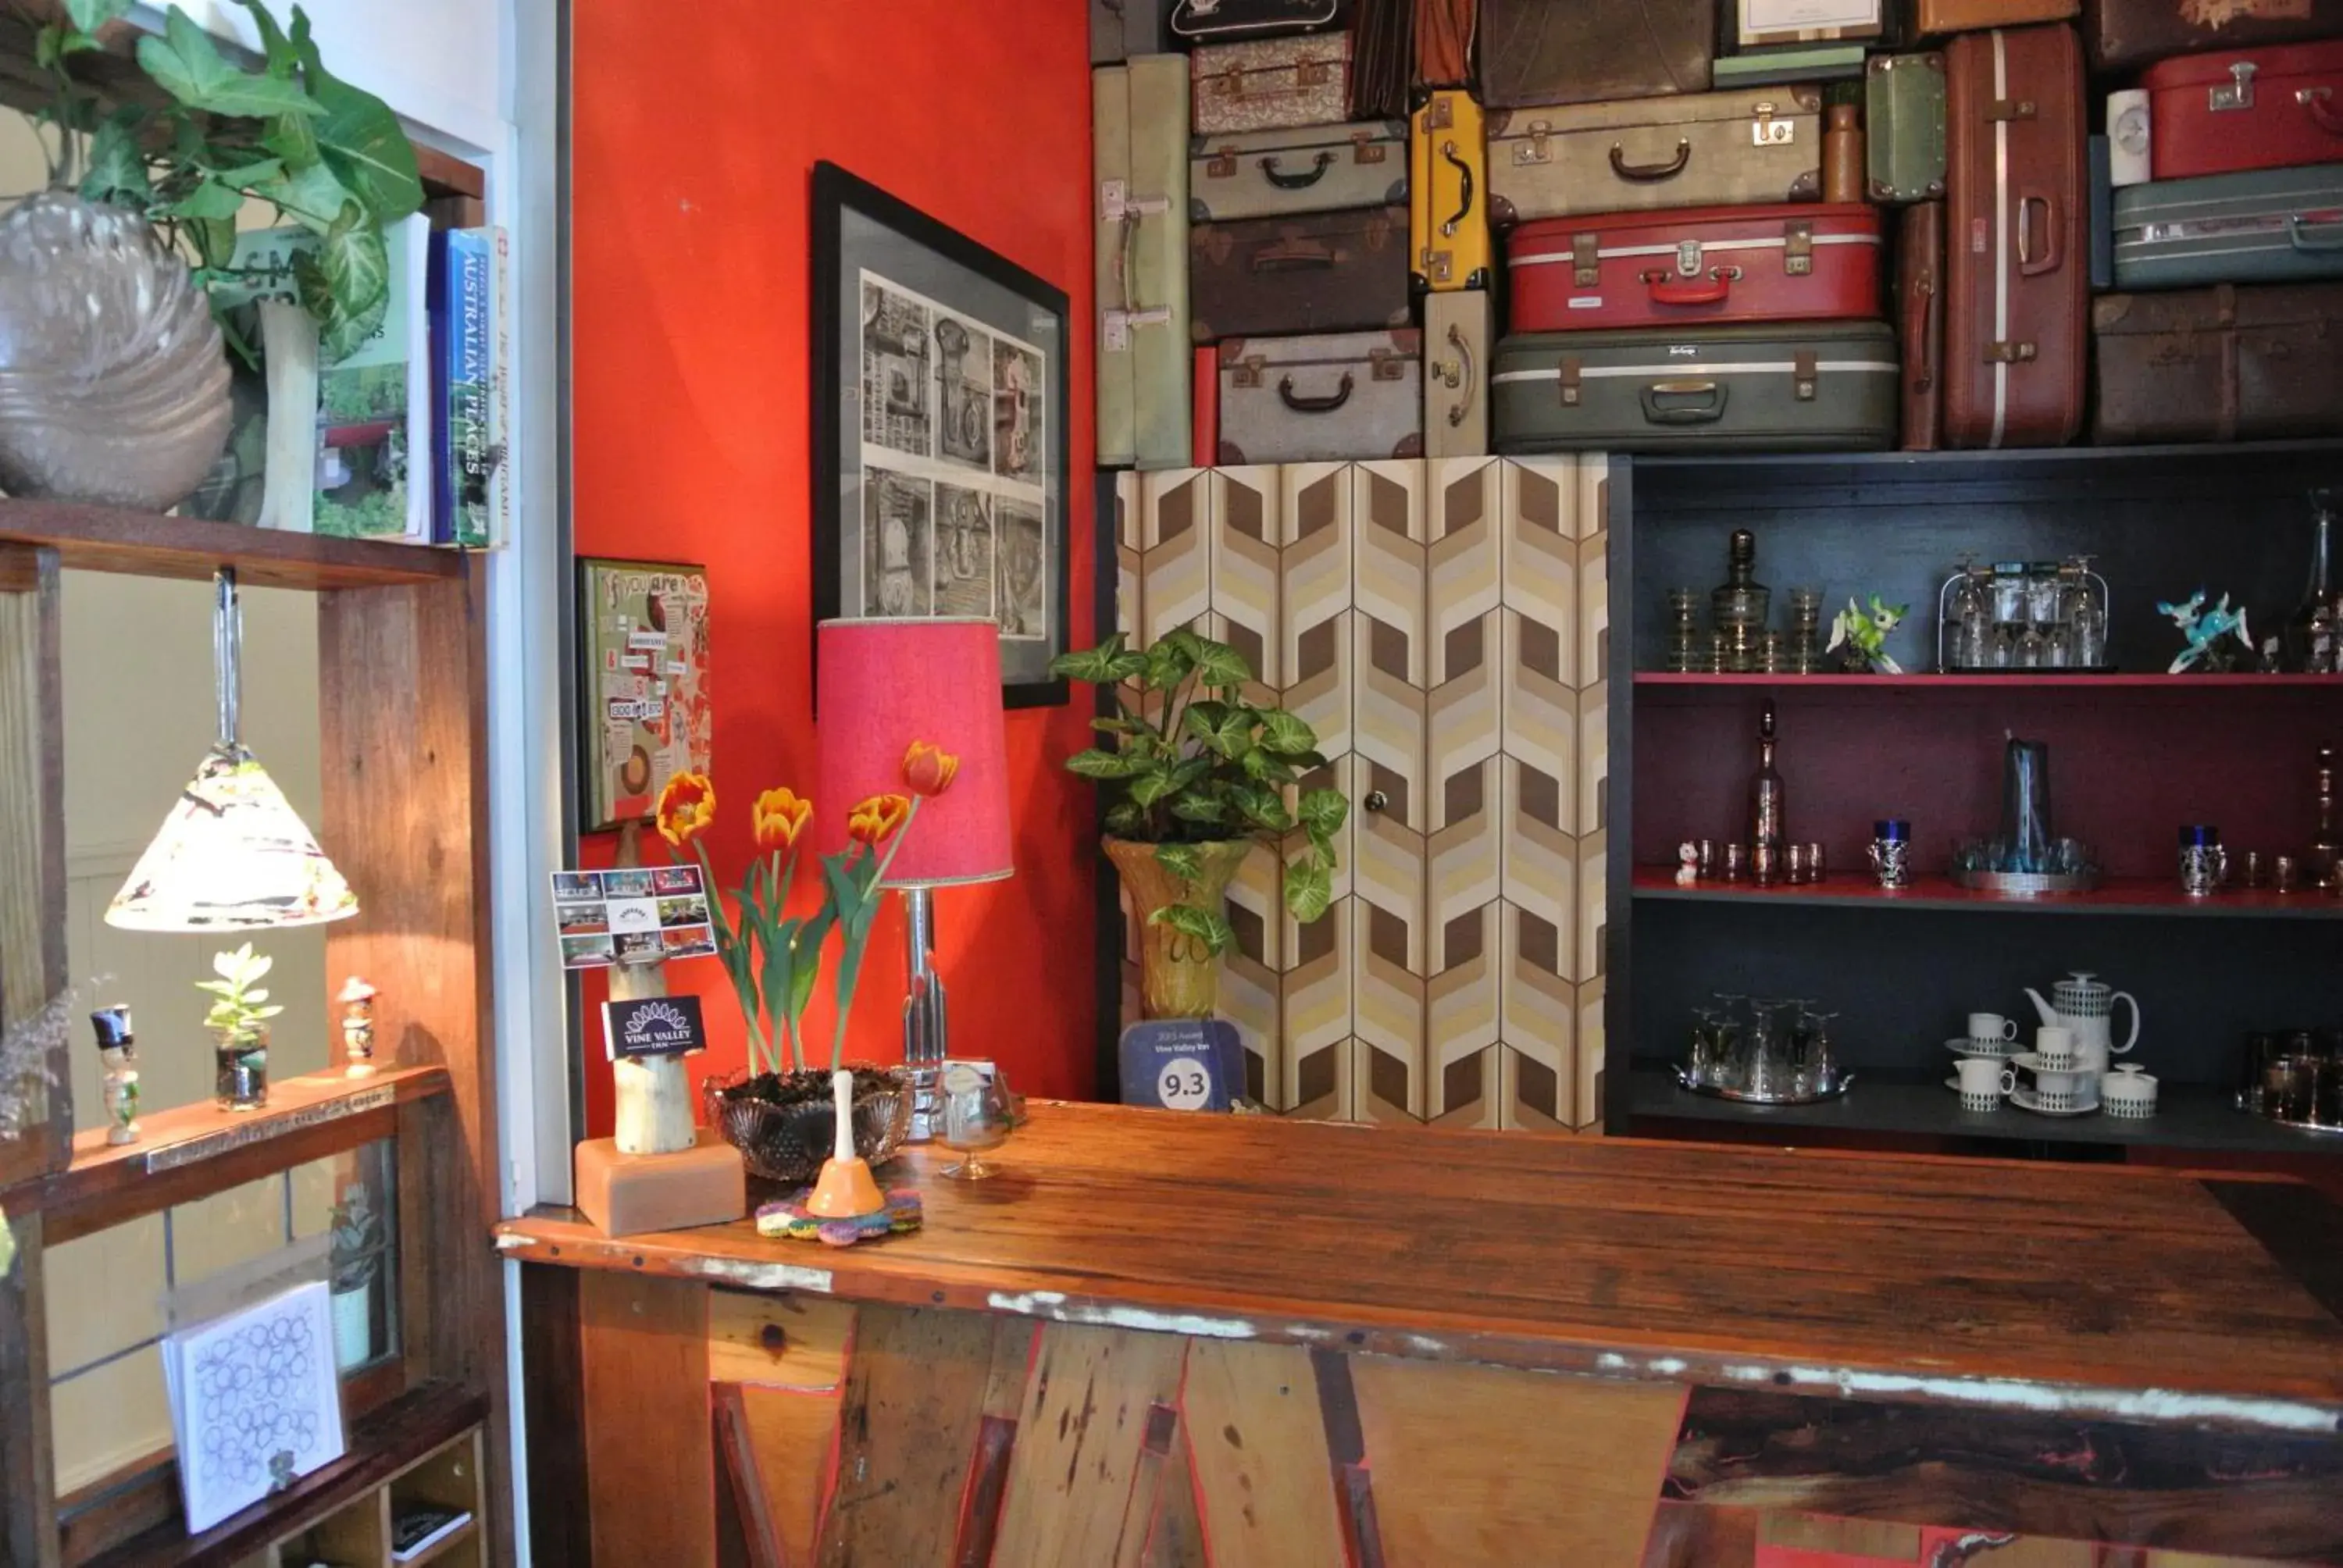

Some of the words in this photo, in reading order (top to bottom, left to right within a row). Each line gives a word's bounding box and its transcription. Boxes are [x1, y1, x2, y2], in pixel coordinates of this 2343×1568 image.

[465, 253, 478, 387] AUSTRALIAN
[465, 395, 479, 474] PLACES
[651, 576, 678, 592] are
[626, 1033, 651, 1043] VINE
[654, 1030, 690, 1040] VALLEY
[1165, 1073, 1204, 1097] 9.3
